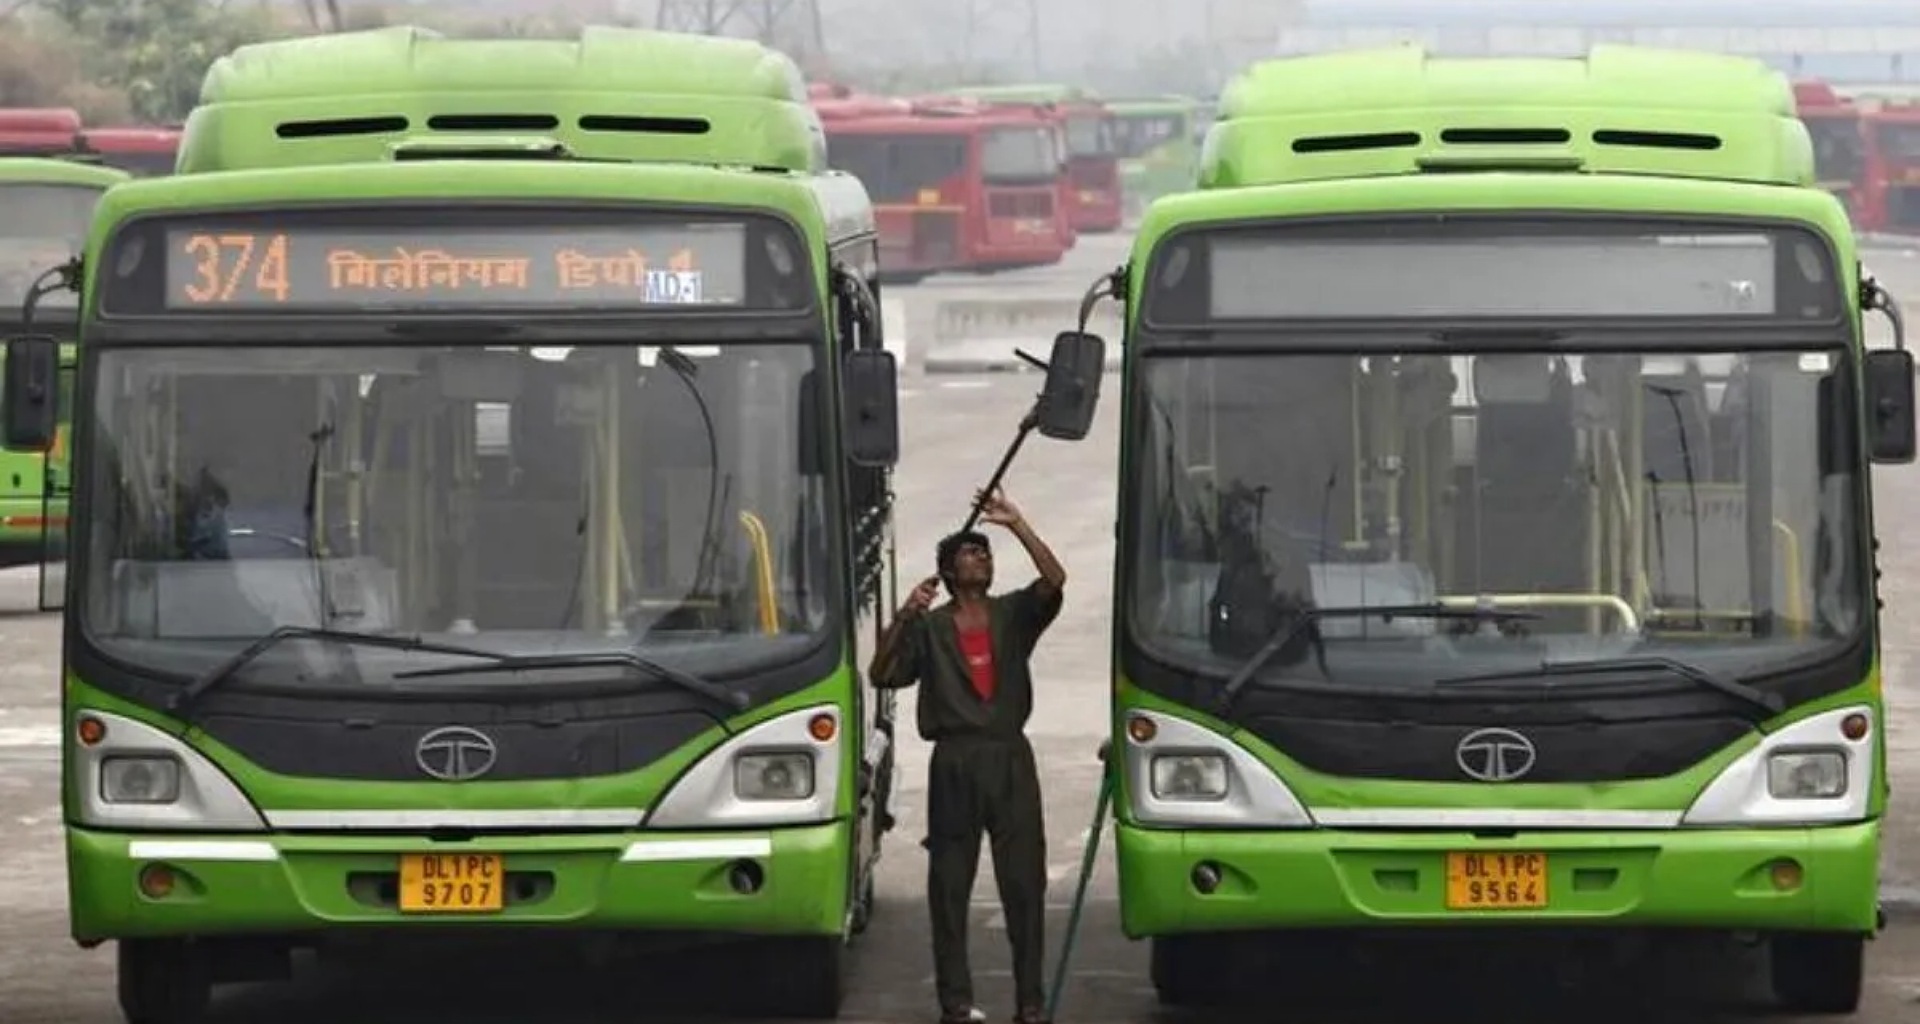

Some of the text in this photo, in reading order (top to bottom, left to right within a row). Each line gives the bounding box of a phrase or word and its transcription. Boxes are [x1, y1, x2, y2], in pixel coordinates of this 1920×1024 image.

[185, 234, 289, 302] 374
[556, 248, 646, 288] डिपो
[423, 883, 490, 905] 9707
[1470, 881, 1536, 902] 9564
